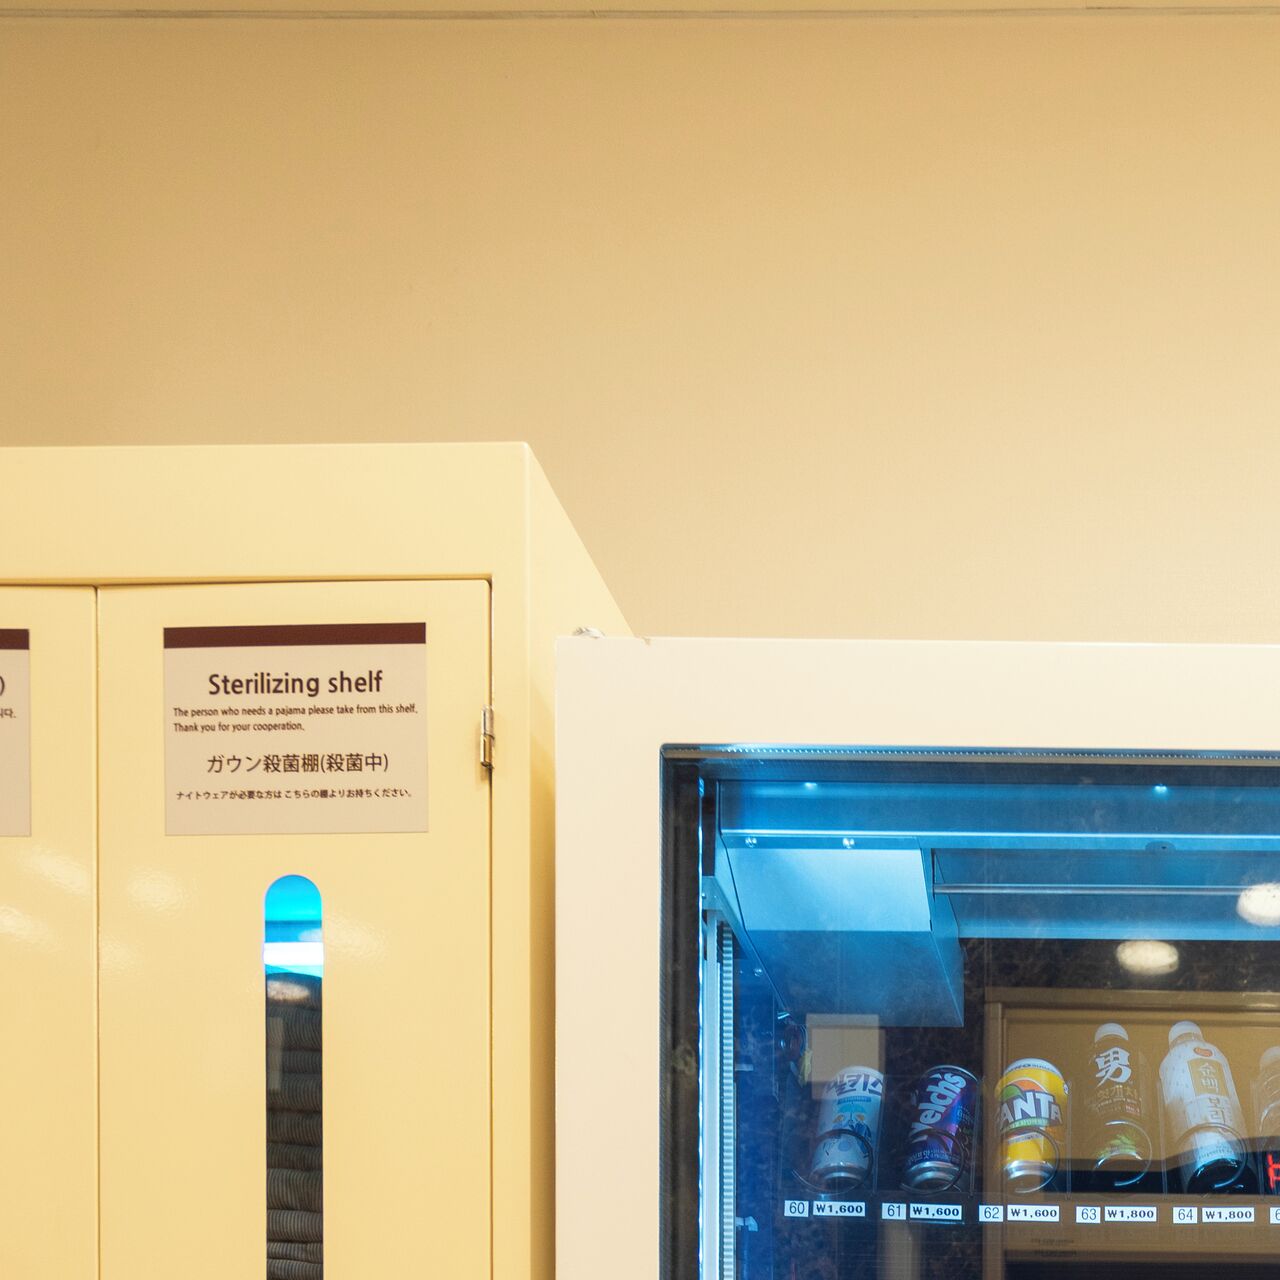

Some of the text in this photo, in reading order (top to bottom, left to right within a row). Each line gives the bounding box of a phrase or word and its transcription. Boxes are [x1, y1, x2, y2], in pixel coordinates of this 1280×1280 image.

[208, 671, 382, 697] Sterilizing shelf
[173, 707, 189, 716] The
[191, 708, 218, 719] person
[221, 707, 239, 716] who
[242, 707, 265, 715] needs
[276, 706, 306, 717] pajama
[308, 705, 334, 717] please
[336, 704, 354, 714] take
[356, 704, 376, 713] from
[378, 704, 393, 713] this
[396, 703, 418, 713] shelf.
[174, 721, 305, 734] Thank you for your cooperation.
[207, 753, 388, 773] ガウン殺菌棚(殺菌中)
[789, 1201, 805, 1215] 60
[983, 1206, 1000, 1220] 62
[1178, 1208, 1193, 1221] 64
